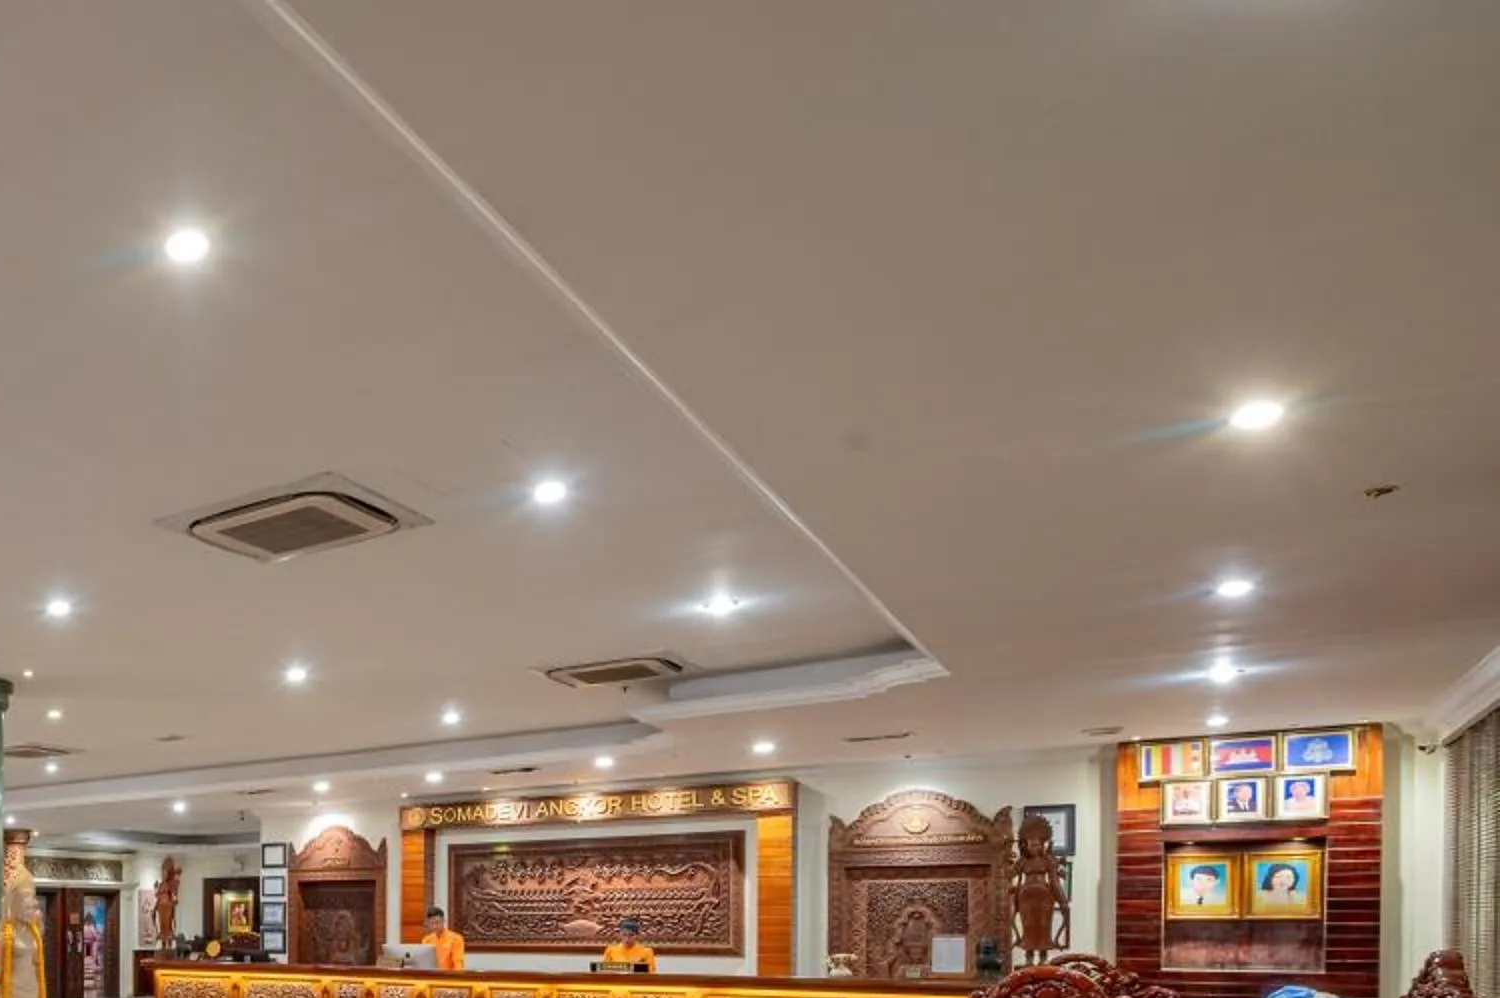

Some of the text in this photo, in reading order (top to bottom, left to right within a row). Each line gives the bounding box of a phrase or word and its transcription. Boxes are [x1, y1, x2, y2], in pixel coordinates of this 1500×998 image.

[430, 803, 530, 825] SOMADEVI
[631, 790, 704, 811] HOTEL
[711, 789, 725, 805] &
[731, 785, 779, 806] SPA
